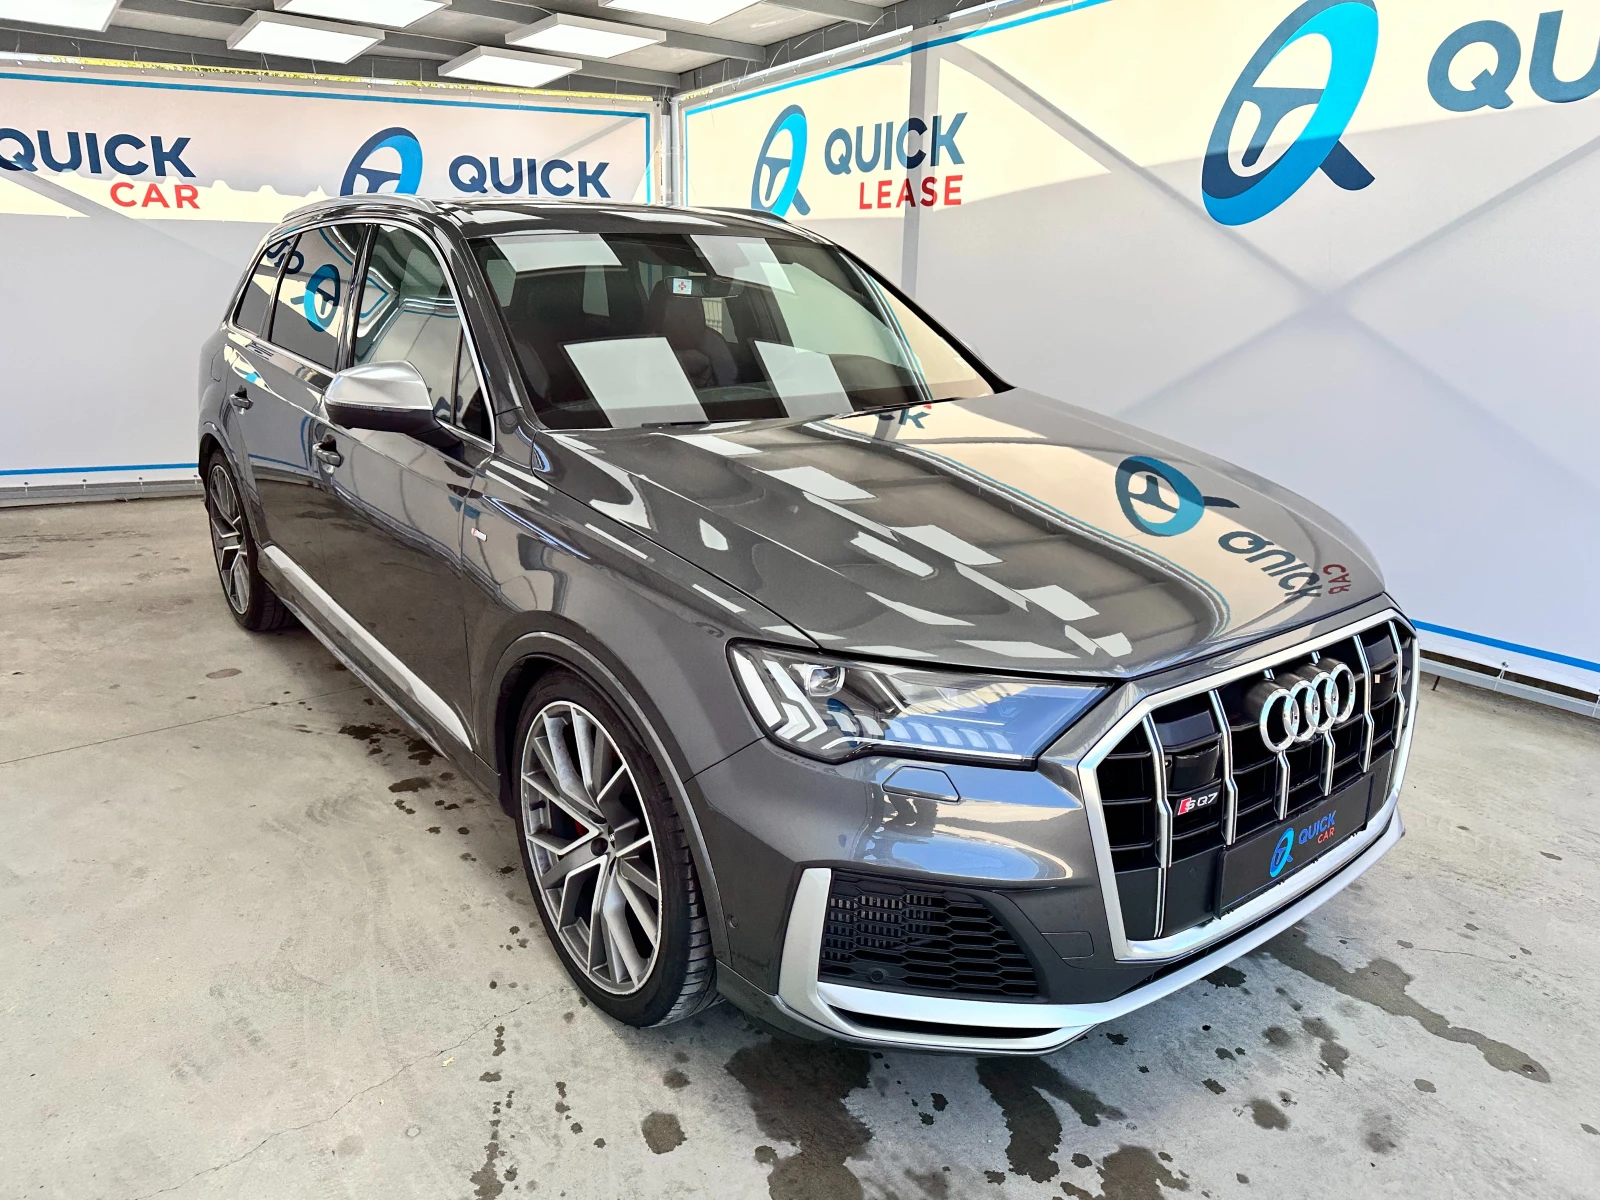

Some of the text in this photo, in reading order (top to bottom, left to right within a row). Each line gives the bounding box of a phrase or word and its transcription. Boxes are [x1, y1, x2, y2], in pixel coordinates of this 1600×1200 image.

[0, 128, 196, 177] QUICK
[824, 112, 968, 175] QUICK
[449, 155, 611, 198] QUICK
[859, 175, 963, 209] LEASE
[110, 182, 200, 209] CAR
[1298, 810, 1336, 844] QUICK
[1317, 827, 1335, 844] CAR
